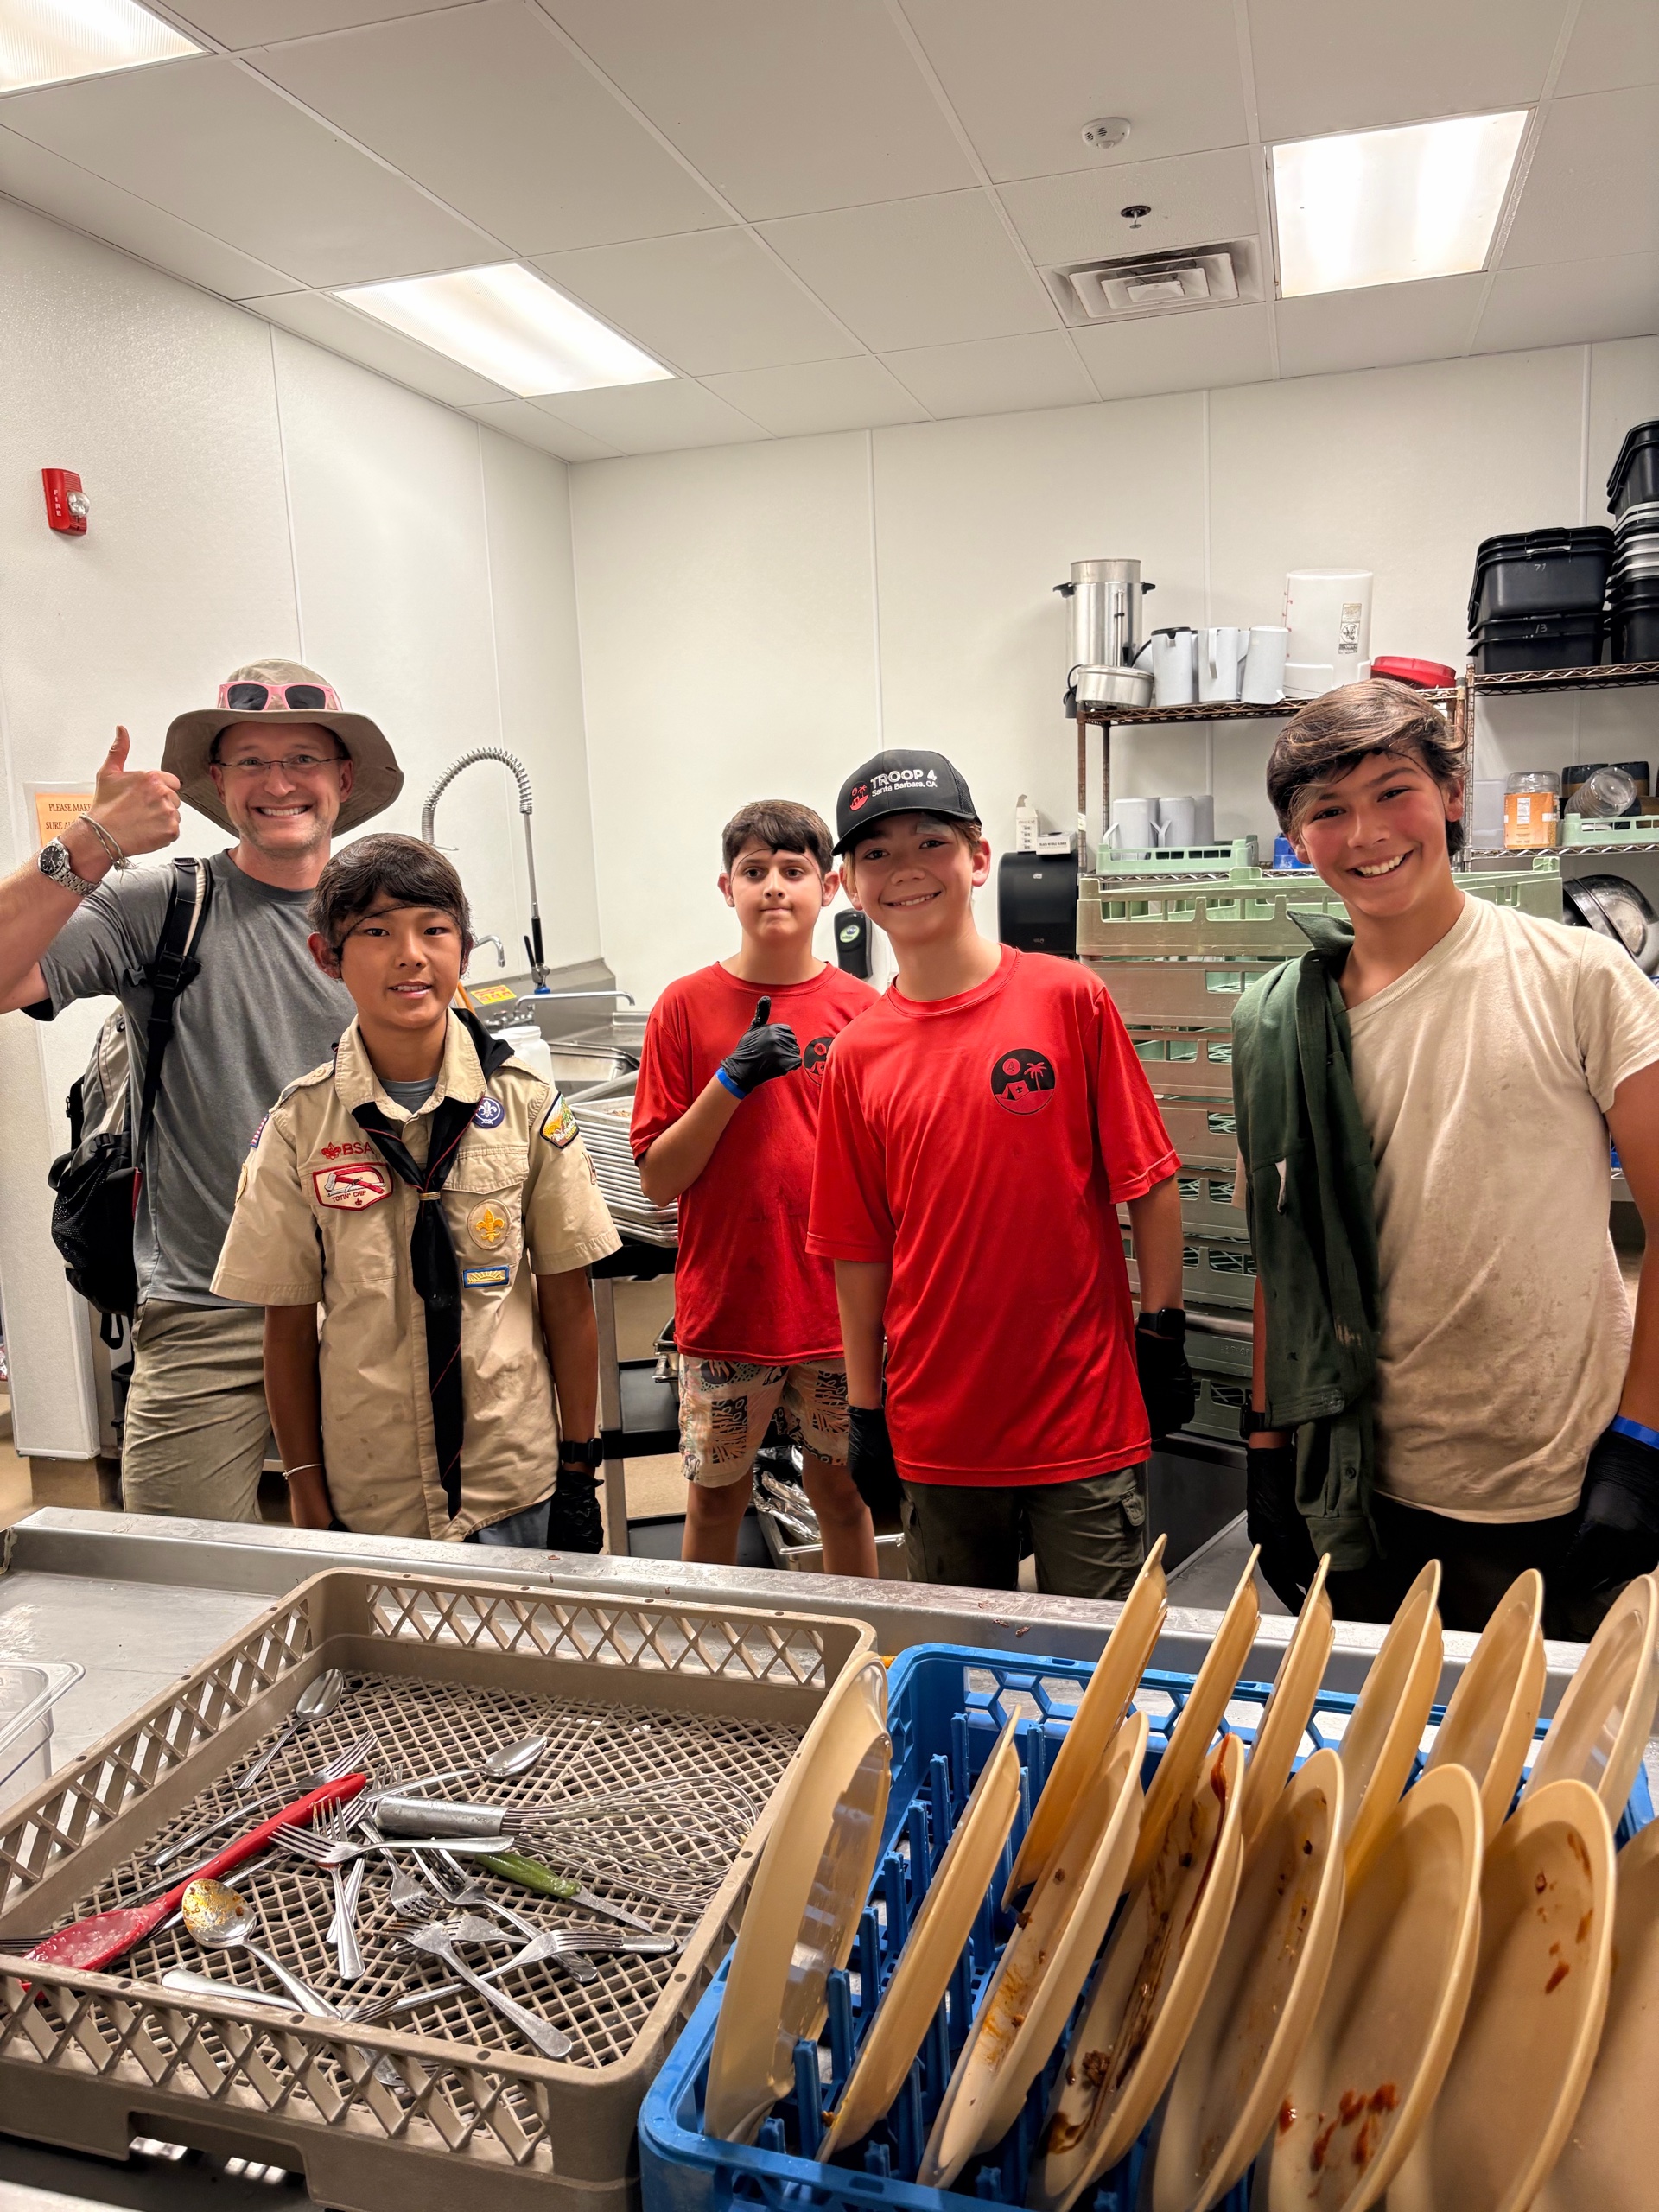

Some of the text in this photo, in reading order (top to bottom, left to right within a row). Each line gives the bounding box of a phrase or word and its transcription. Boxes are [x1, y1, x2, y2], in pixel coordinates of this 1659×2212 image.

[1535, 624, 1548, 633] 13
[870, 769, 938, 790] TROOP 4
[872, 785, 893, 797] Santa
[893, 781, 925, 790] Barbara,
[48, 804, 72, 812] PLEASE
[45, 821, 63, 830] SURE
[342, 1141, 375, 1155] BSA
